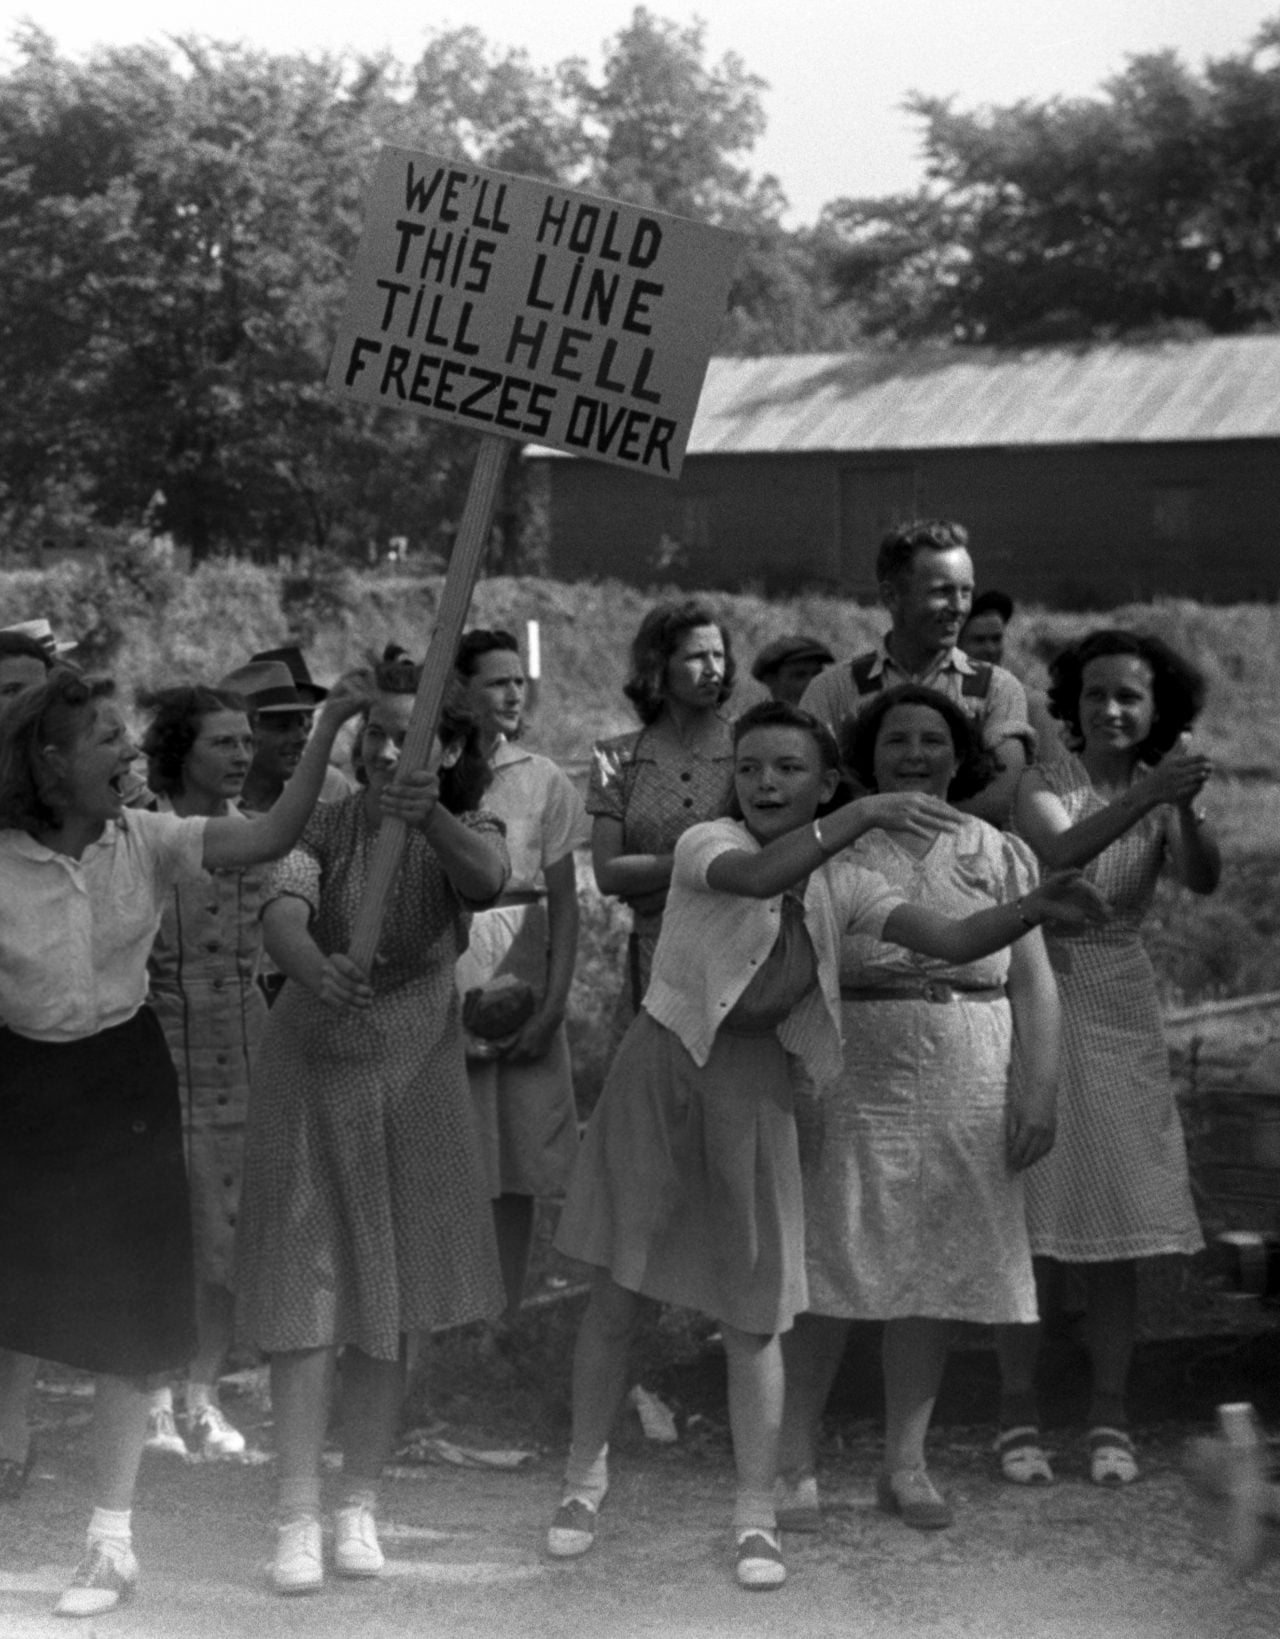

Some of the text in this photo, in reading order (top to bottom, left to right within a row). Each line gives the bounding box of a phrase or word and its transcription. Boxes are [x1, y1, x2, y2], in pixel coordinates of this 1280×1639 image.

[405, 161, 663, 269] WE'LL HOLD
[396, 219, 664, 335] THIS LINE
[376, 279, 662, 404] TILL HELL
[345, 337, 677, 472] FREEZES OVER
